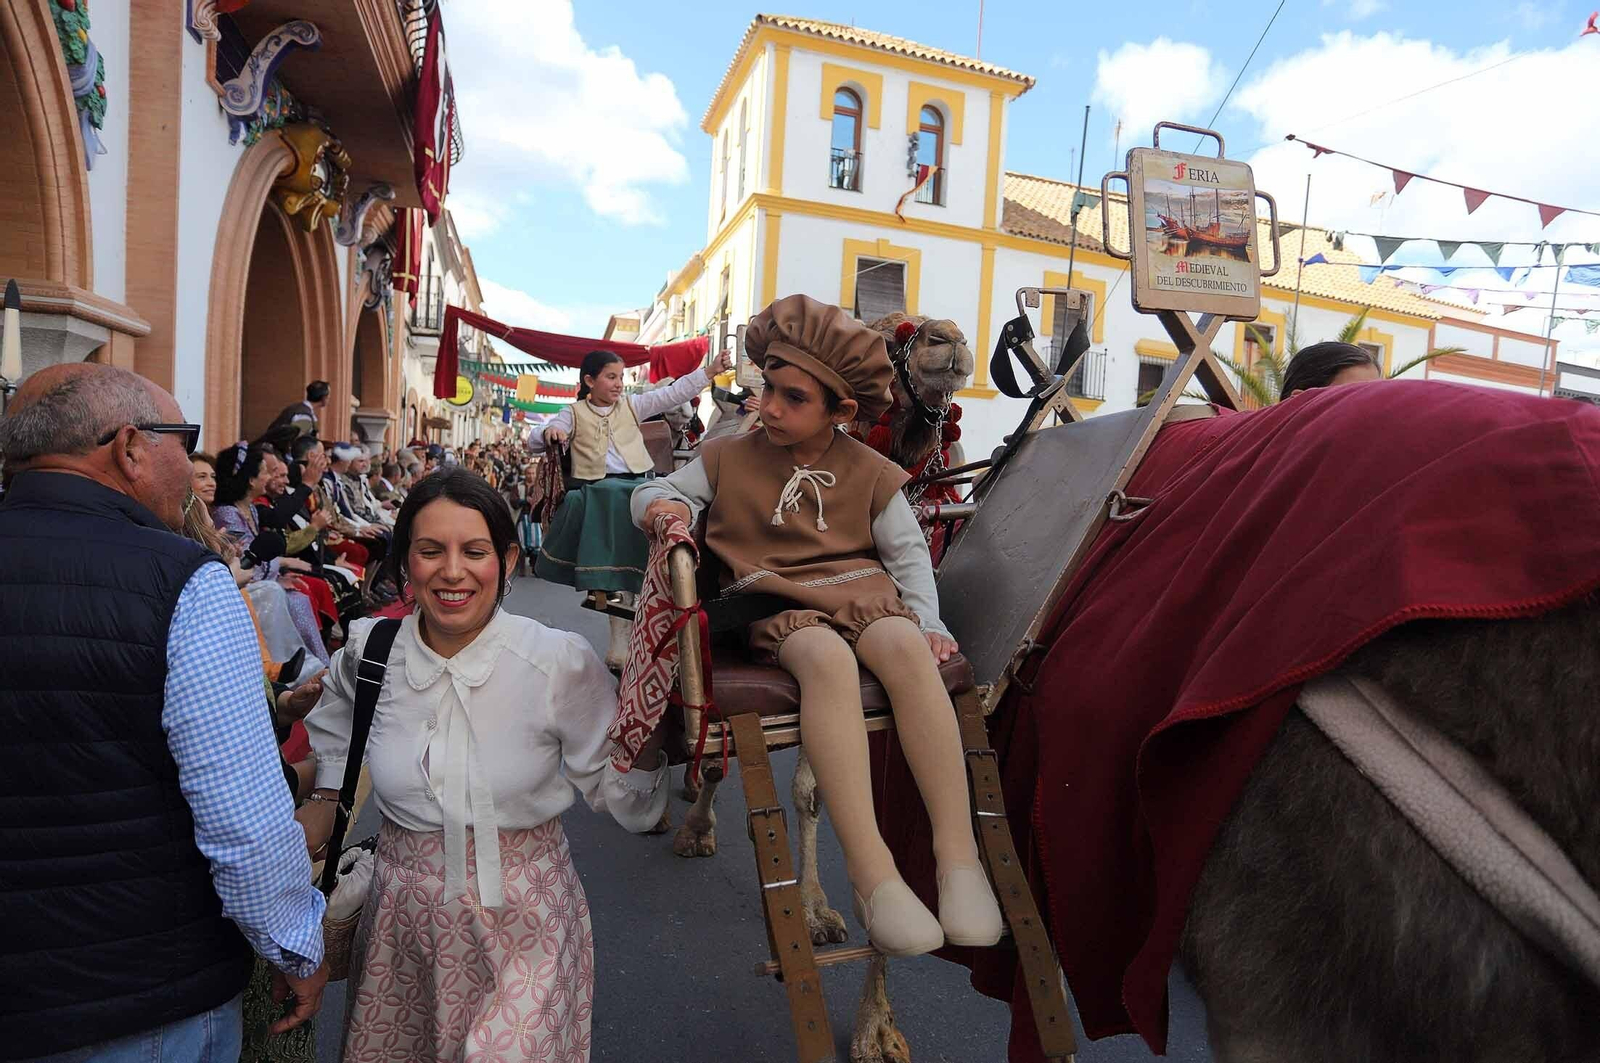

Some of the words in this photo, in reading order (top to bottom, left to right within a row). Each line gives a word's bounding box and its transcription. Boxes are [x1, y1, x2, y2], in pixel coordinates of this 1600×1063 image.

[1172, 162, 1220, 183] FERIA
[1175, 260, 1229, 277] MEDIEVAL
[1156, 275, 1174, 286] DEL
[1175, 277, 1247, 292] DESCUBRIMIENTO
